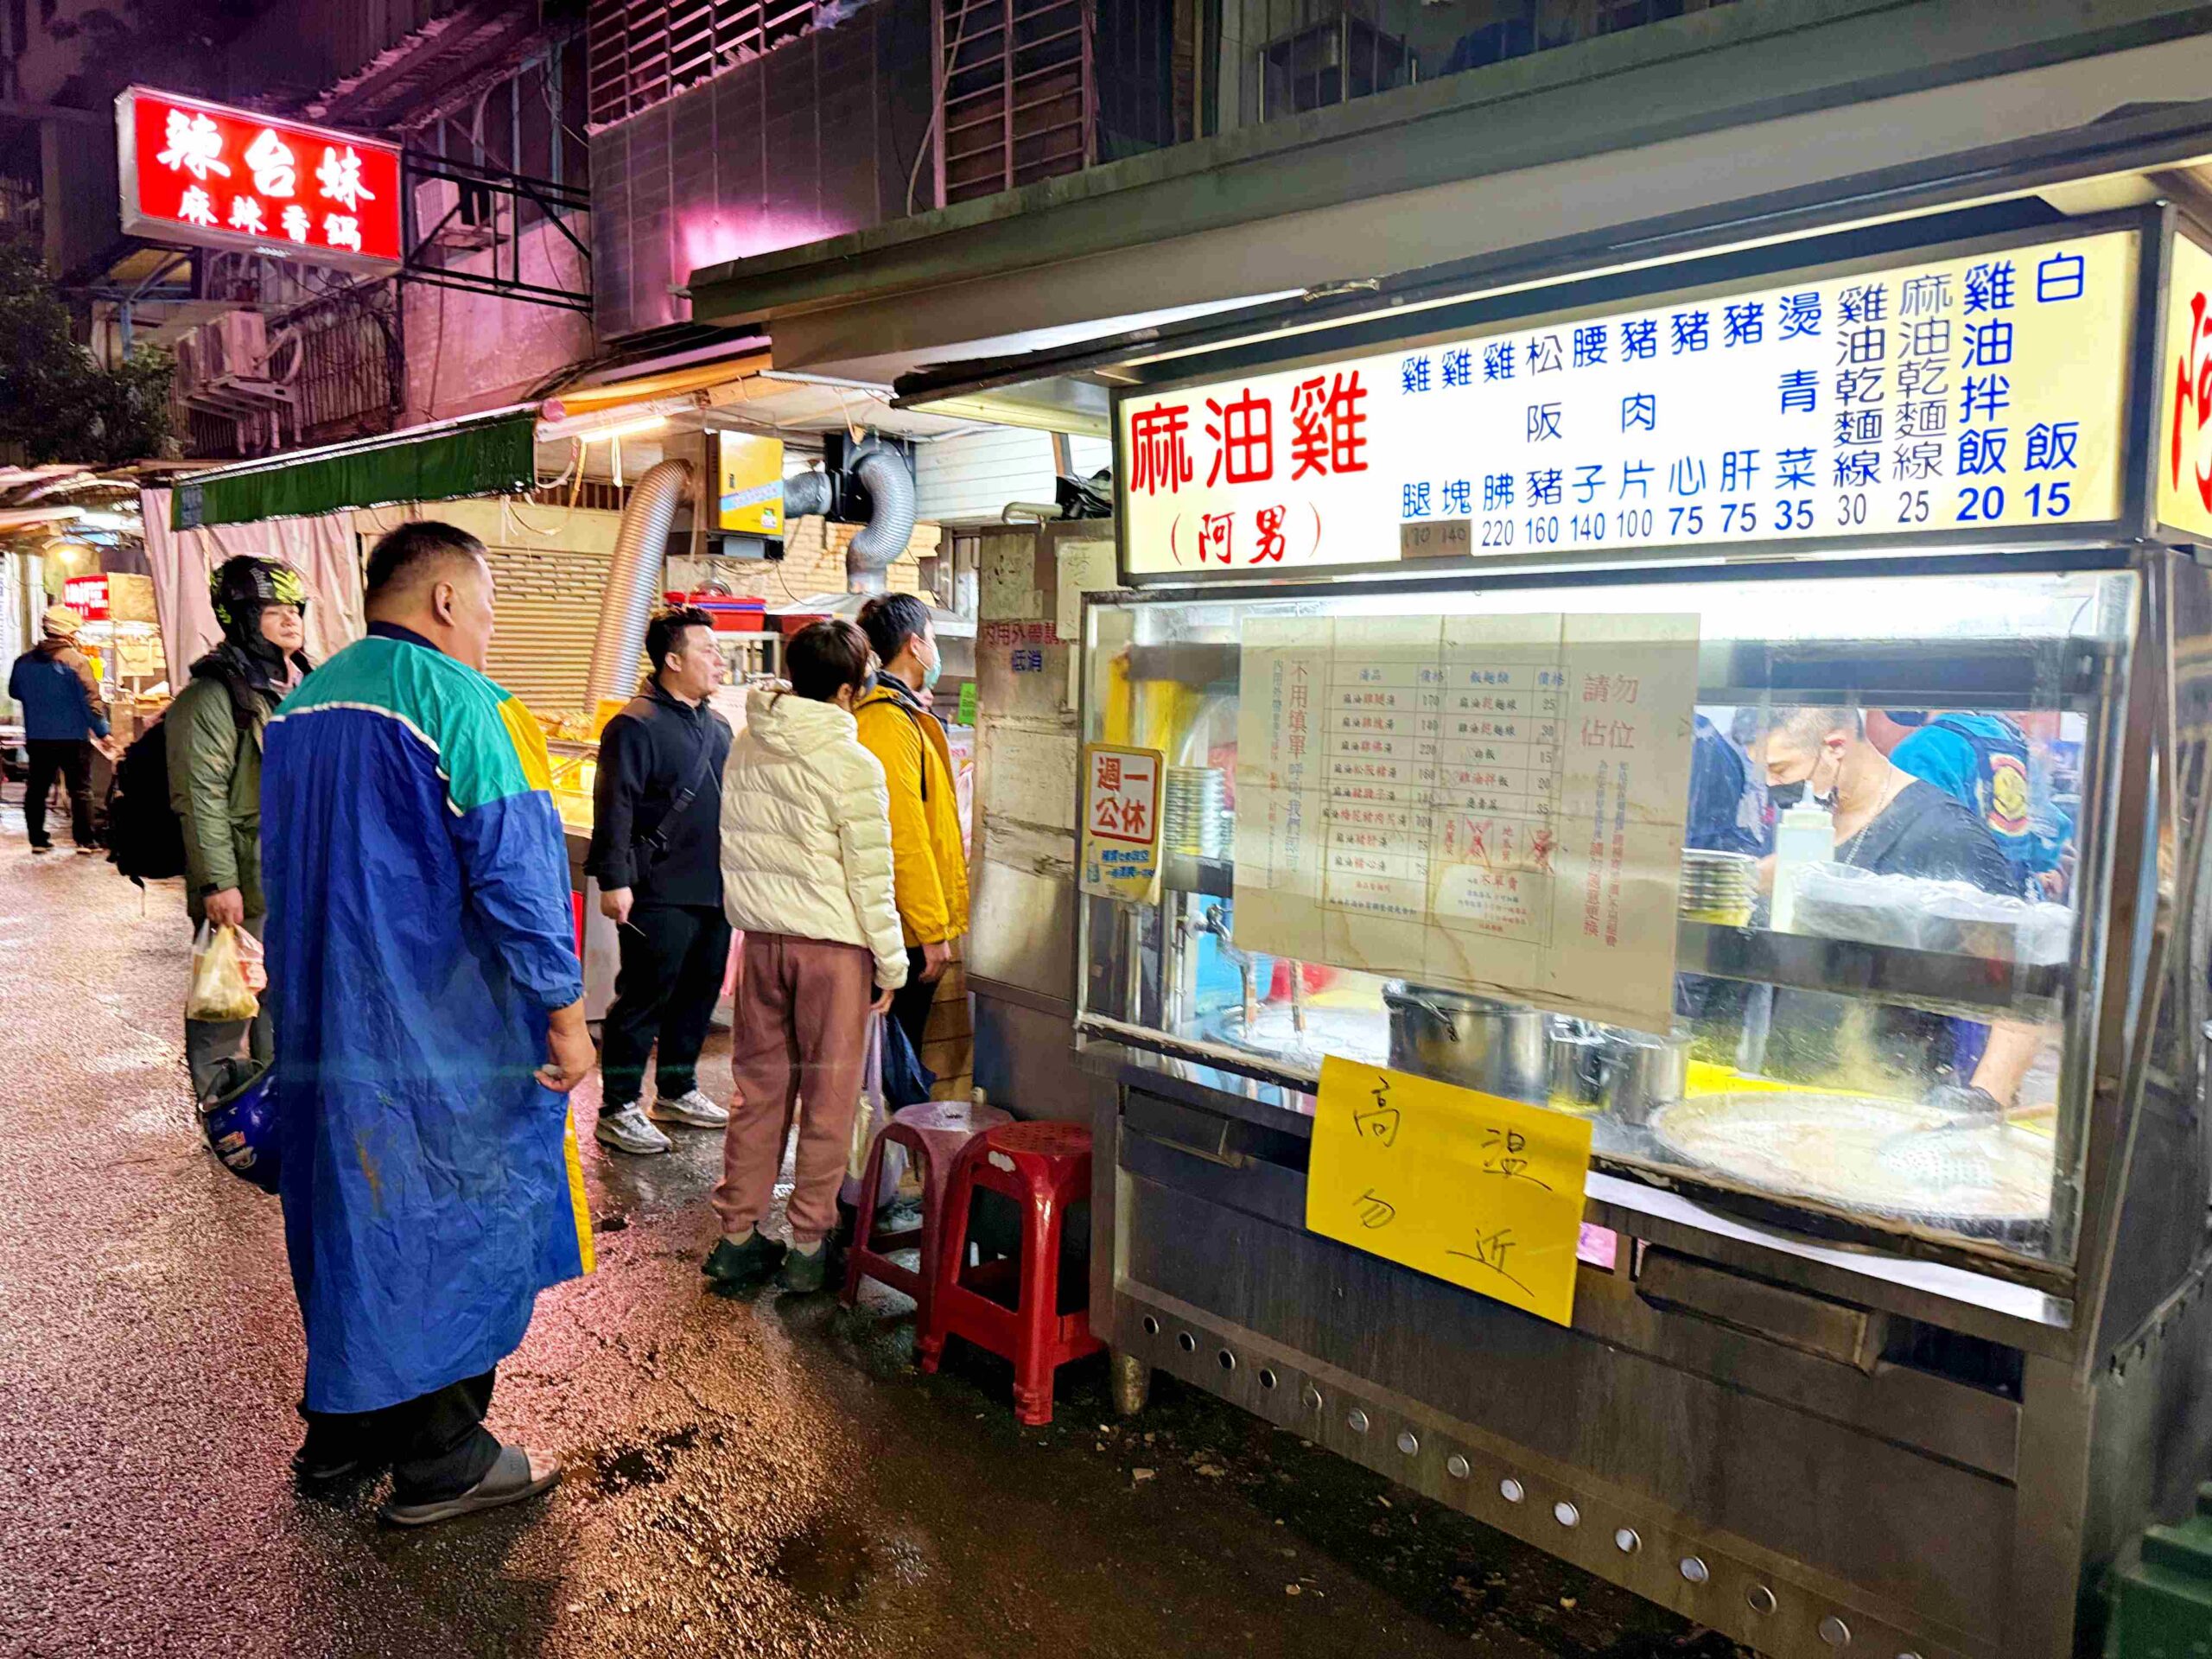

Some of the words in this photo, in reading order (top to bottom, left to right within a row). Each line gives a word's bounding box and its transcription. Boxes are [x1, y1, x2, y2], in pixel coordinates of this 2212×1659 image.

[156, 109, 375, 212] 辣台妹
[178, 185, 361, 252] 麻辣香鍋
[1833, 282, 1889, 488] 雞油乾麵線
[1892, 273, 1953, 481] 麻油乾麵線
[1955, 259, 2017, 477] 雞油拌飯
[1618, 317, 1658, 499] 豬肉片
[1775, 291, 1822, 491] 燙青菜
[1131, 370, 1369, 497] 麻油雞
[1526, 334, 1562, 508] 松阪豬
[1720, 502, 1758, 532] 75
[1774, 499, 1815, 531] 35
[1837, 493, 1867, 526] 30
[1897, 489, 1929, 524] 25
[1955, 486, 2005, 522] 20
[2023, 481, 2071, 518] 15
[1482, 519, 1514, 547] 220
[1525, 516, 1559, 544] 160
[1570, 512, 1605, 542] 140
[1617, 508, 1653, 539] 100
[1669, 505, 1704, 536] 75
[1581, 672, 1639, 705] 請勿
[1580, 715, 1637, 750] 佔位
[1097, 756, 1149, 792] 週一
[1540, 751, 1553, 764] 15
[1095, 796, 1147, 835] 公休
